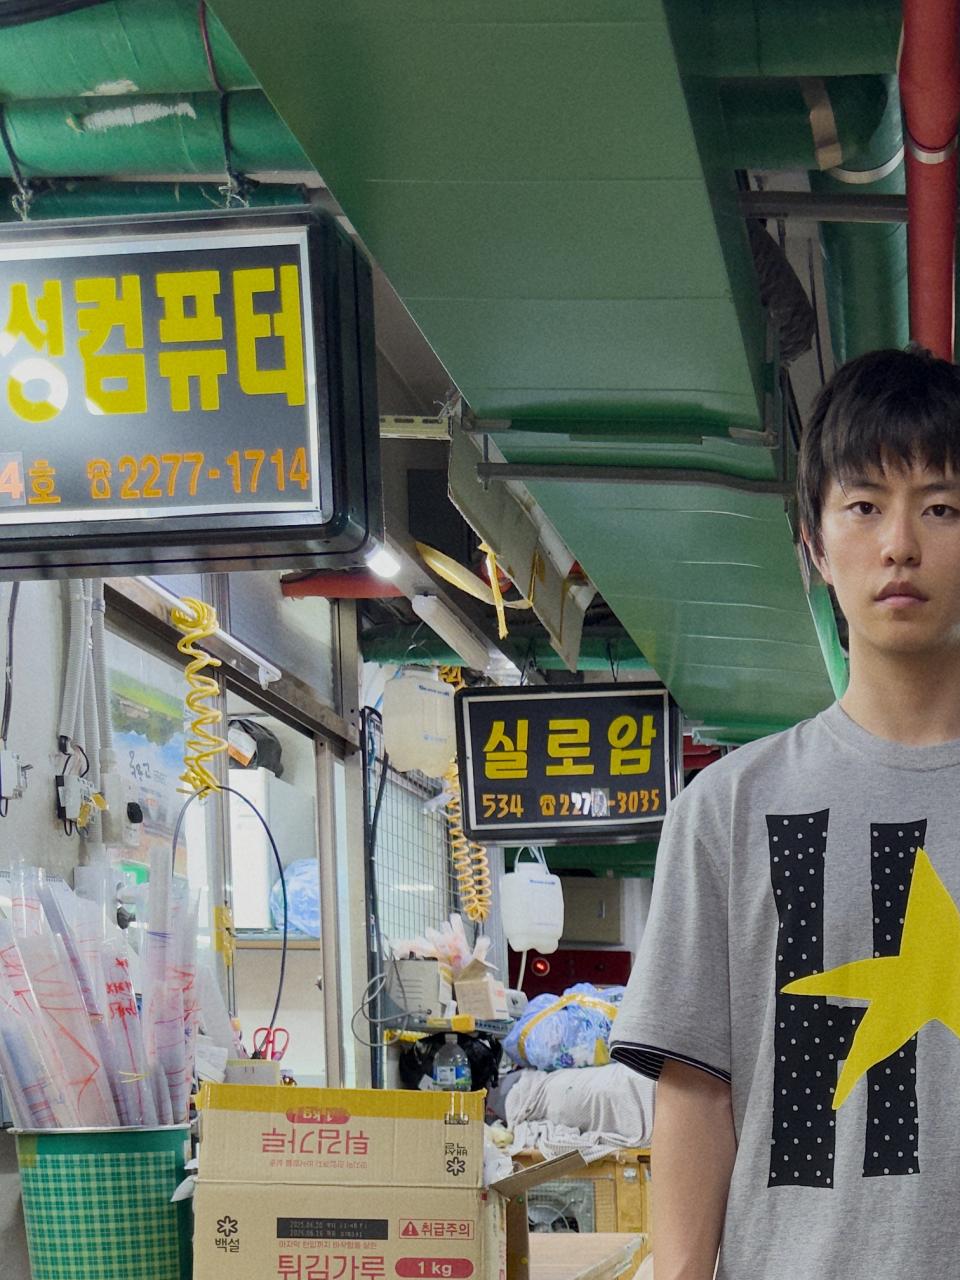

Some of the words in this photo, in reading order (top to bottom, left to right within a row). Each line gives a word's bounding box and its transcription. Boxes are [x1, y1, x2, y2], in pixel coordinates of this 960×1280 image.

[0, 264, 306, 423] 성컴퓨터
[119, 447, 310, 500] 2277-1714
[483, 714, 657, 780] 실로암
[482, 793, 524, 818] 534
[559, 788, 660, 817] 227-3035
[261, 1128, 371, 1156] 튀김가루
[421, 1221, 471, 1238] 취급주의
[215, 1237, 241, 1254] 백설
[431, 1260, 452, 1278] kg
